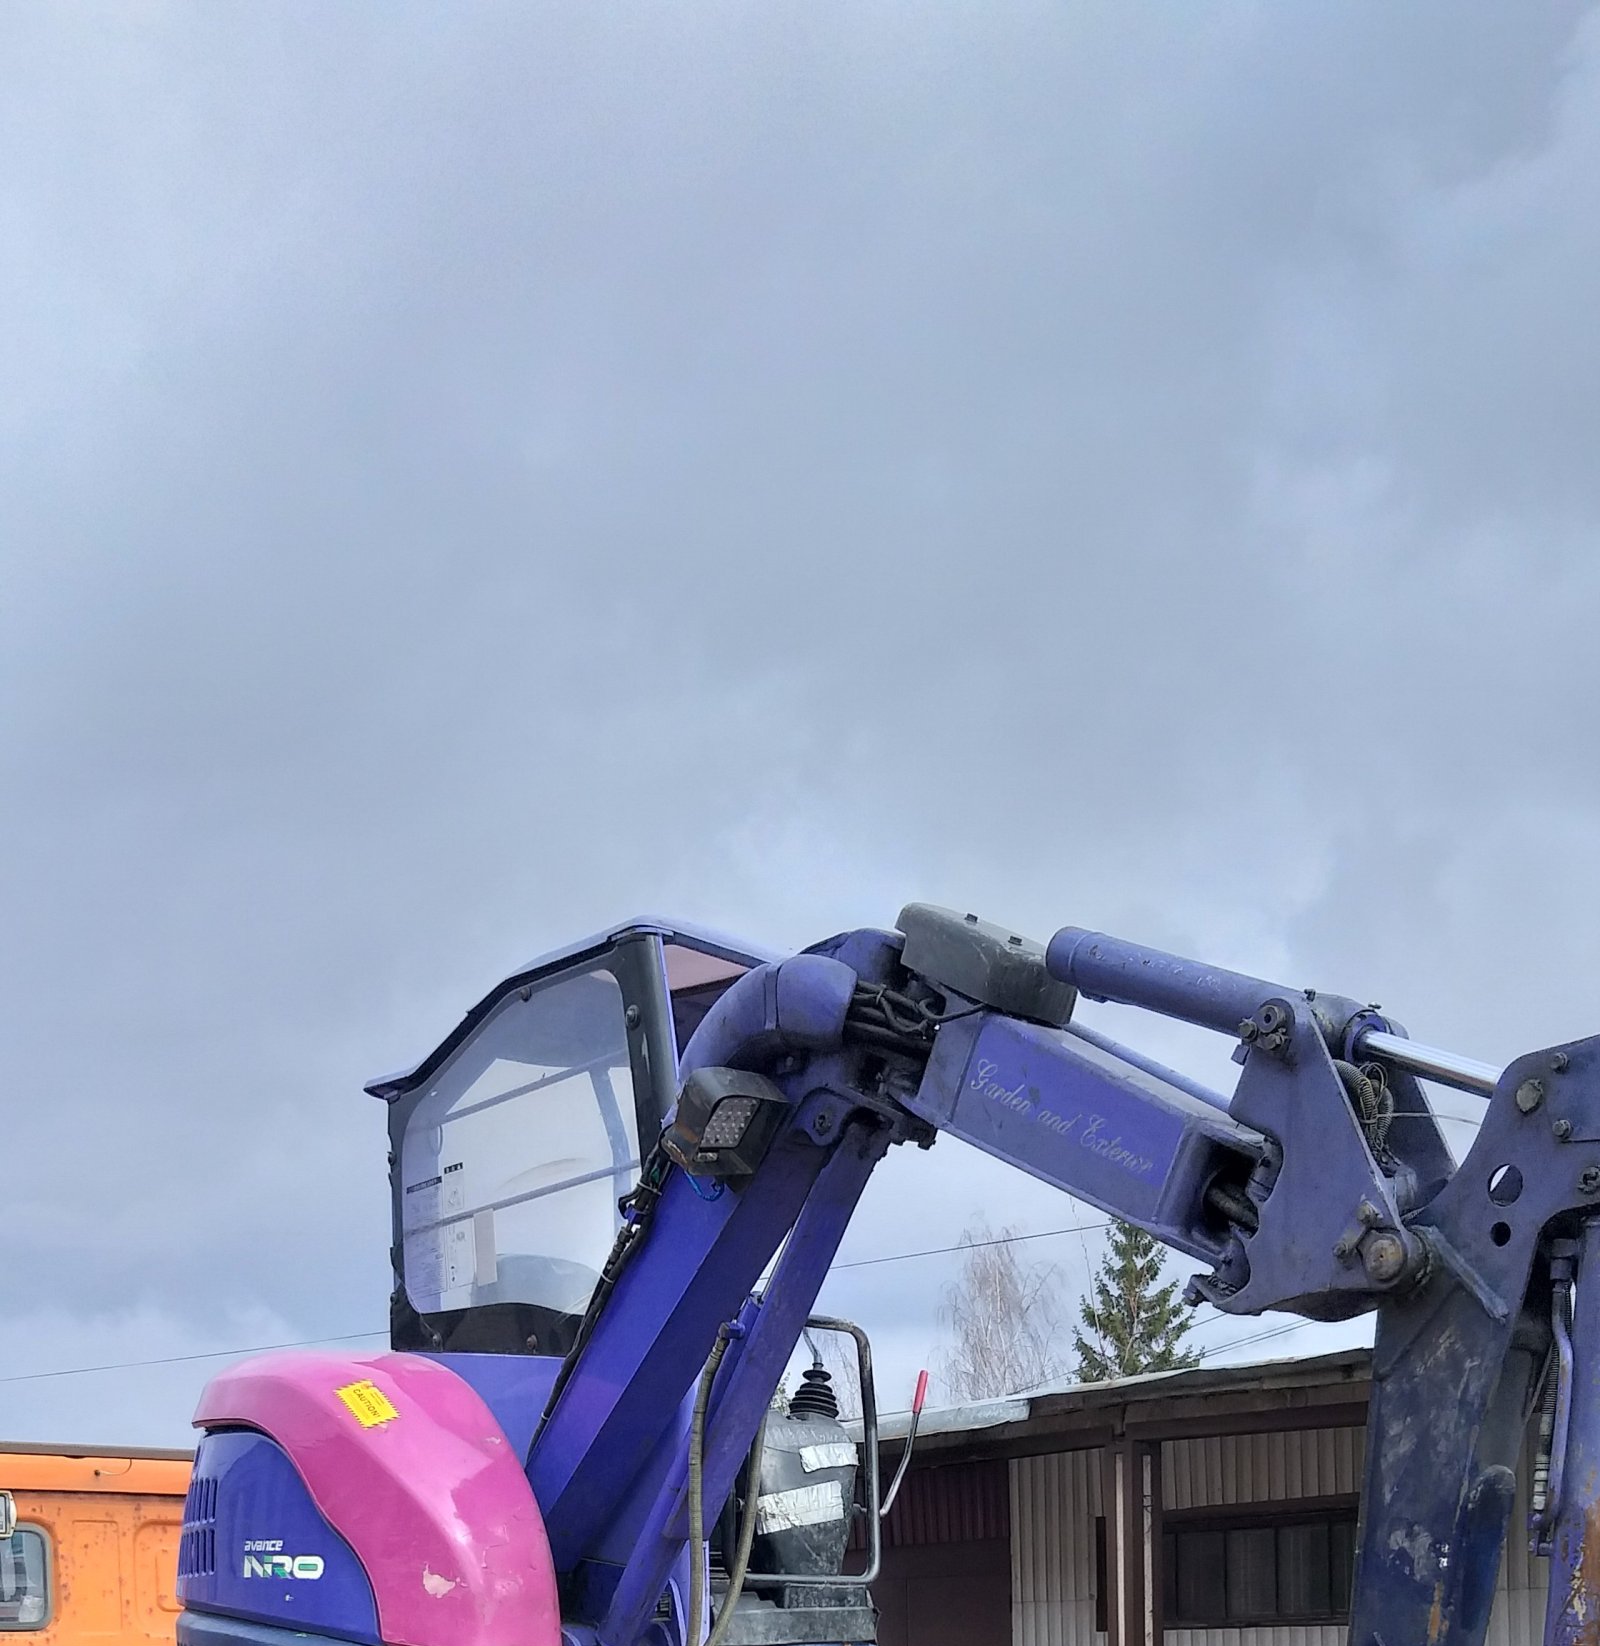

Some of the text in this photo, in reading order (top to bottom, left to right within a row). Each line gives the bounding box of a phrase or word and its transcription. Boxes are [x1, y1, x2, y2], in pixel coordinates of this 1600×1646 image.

[970, 1058, 1031, 1116] Garden
[1037, 1110, 1083, 1136] and
[353, 1388, 381, 1417] CAUTION!
[244, 1540, 284, 1552] avance
